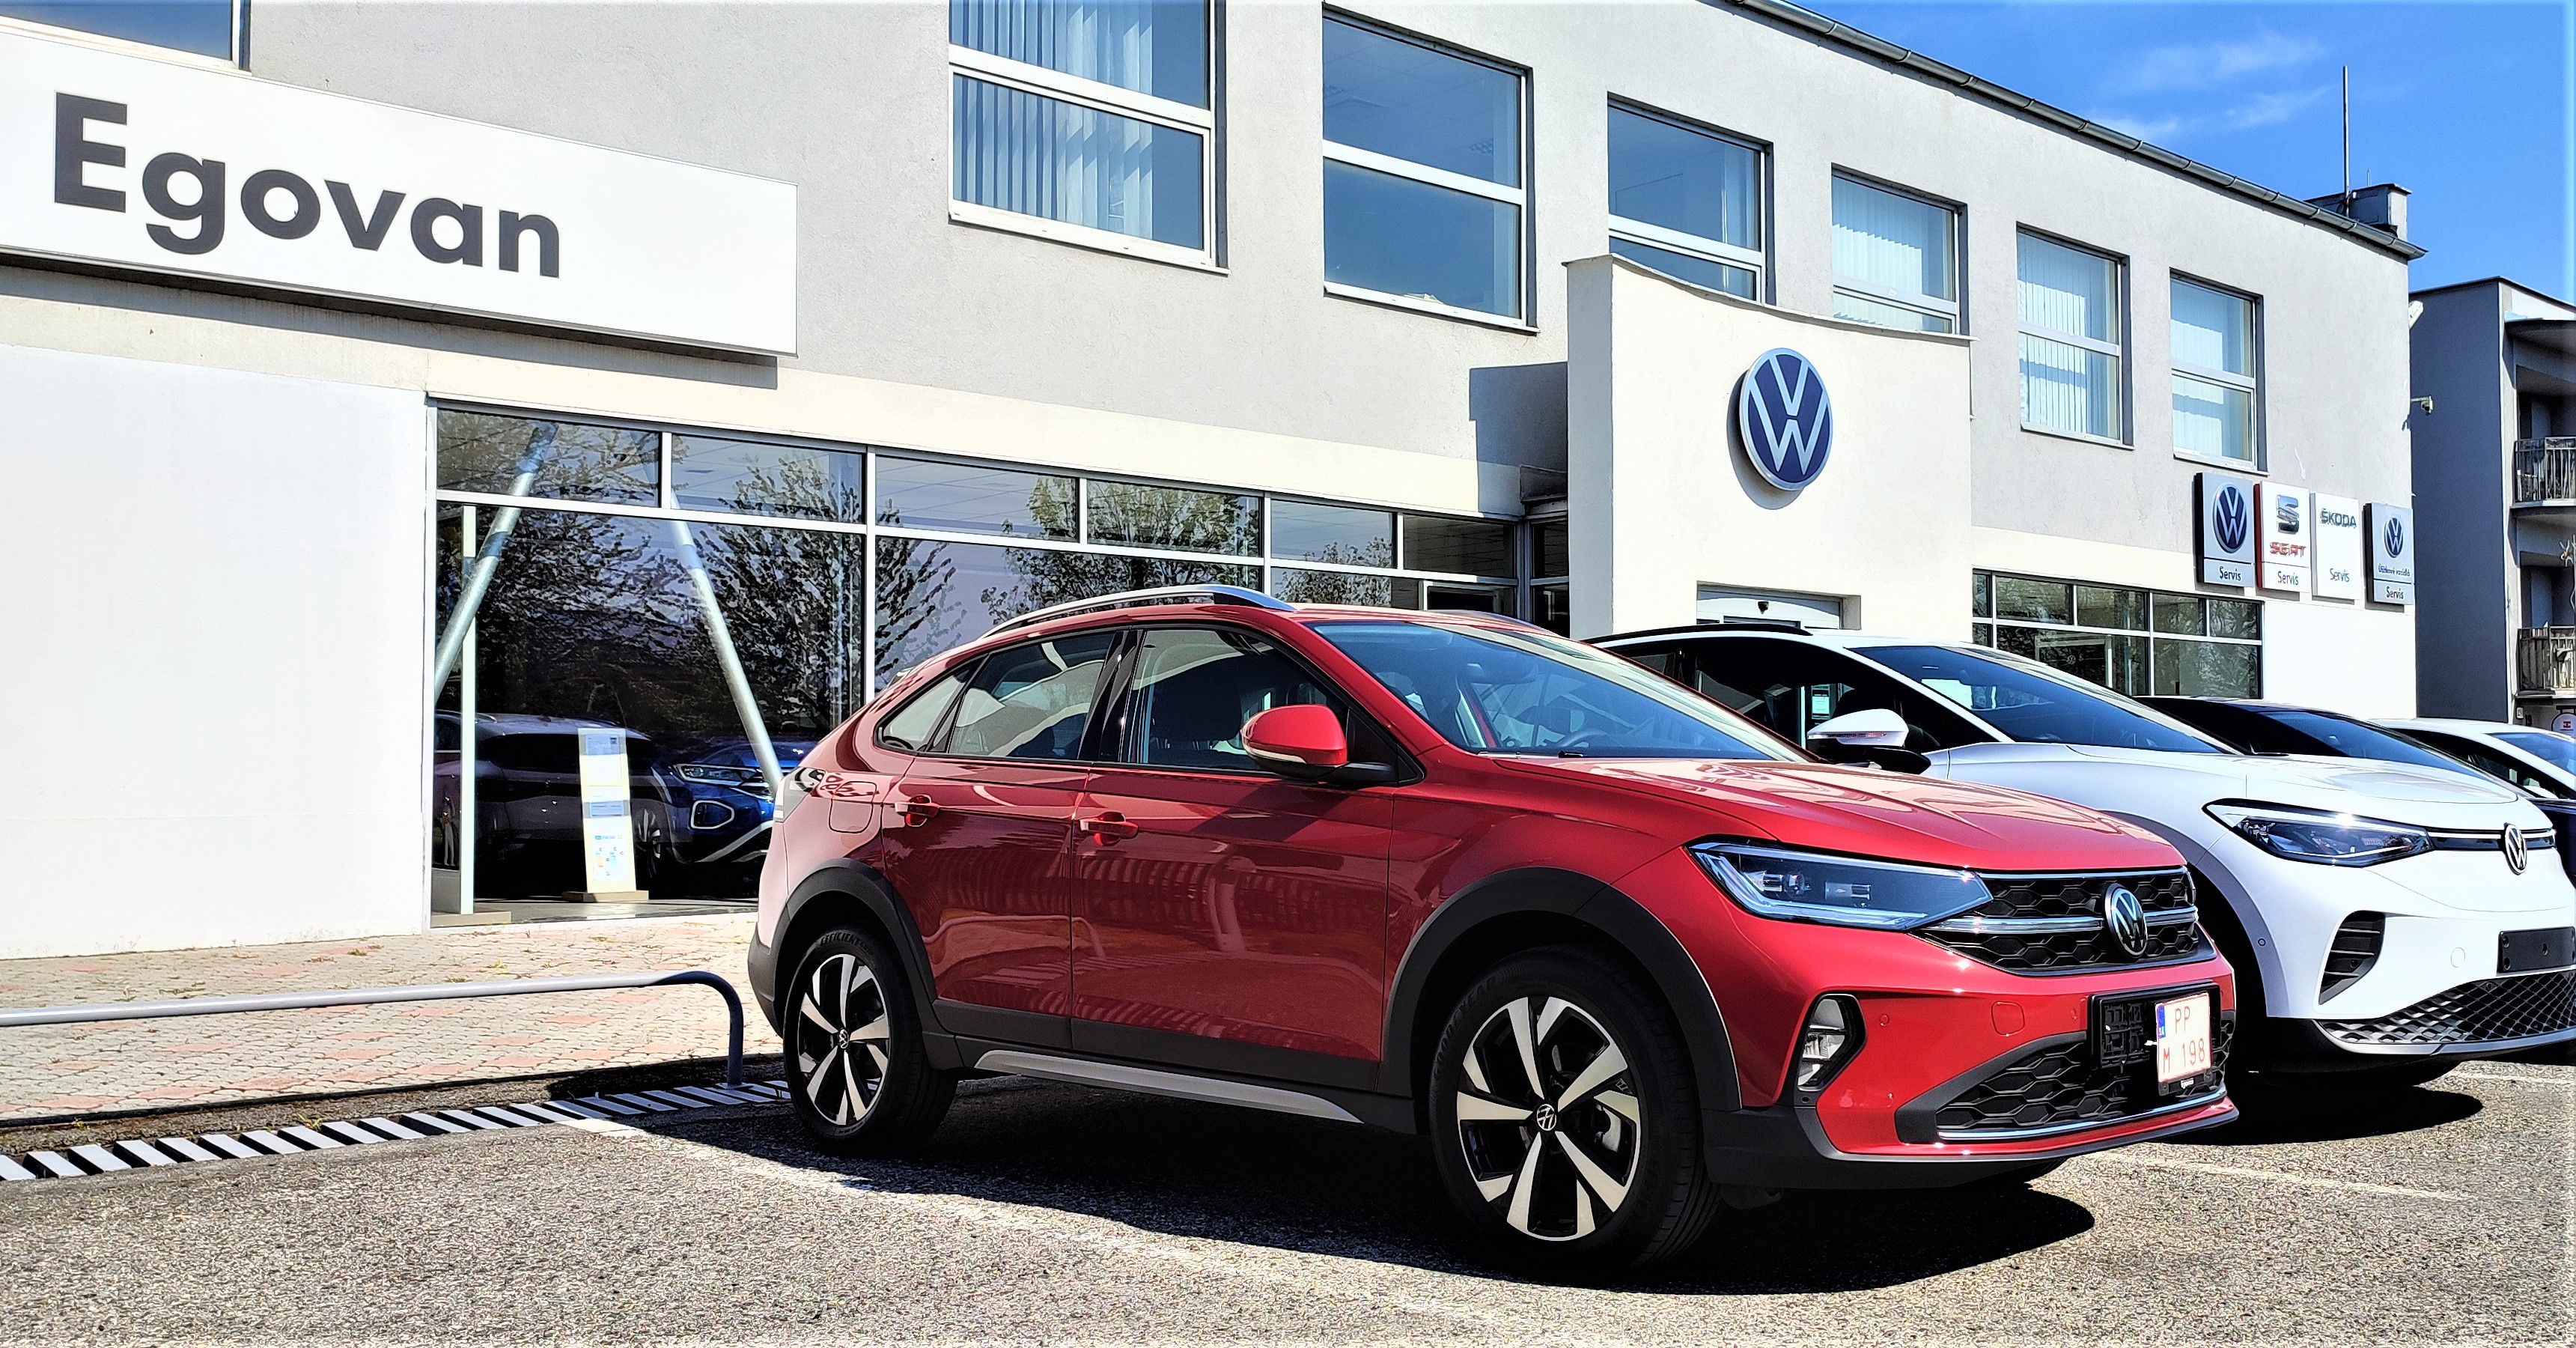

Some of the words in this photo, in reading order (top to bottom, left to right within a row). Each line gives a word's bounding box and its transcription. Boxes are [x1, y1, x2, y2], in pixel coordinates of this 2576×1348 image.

[54, 90, 560, 278] Egovan
[2320, 508, 2357, 529] ŠKODA
[2269, 541, 2307, 558] SEAT
[2219, 565, 2241, 581] Servis
[2277, 570, 2299, 586] Servis
[2329, 568, 2350, 583] Servis
[2386, 586, 2404, 600] Servis
[2175, 1006, 2190, 1034] PP
[2163, 1046, 2170, 1074] M
[2181, 1037, 2205, 1069] 198
